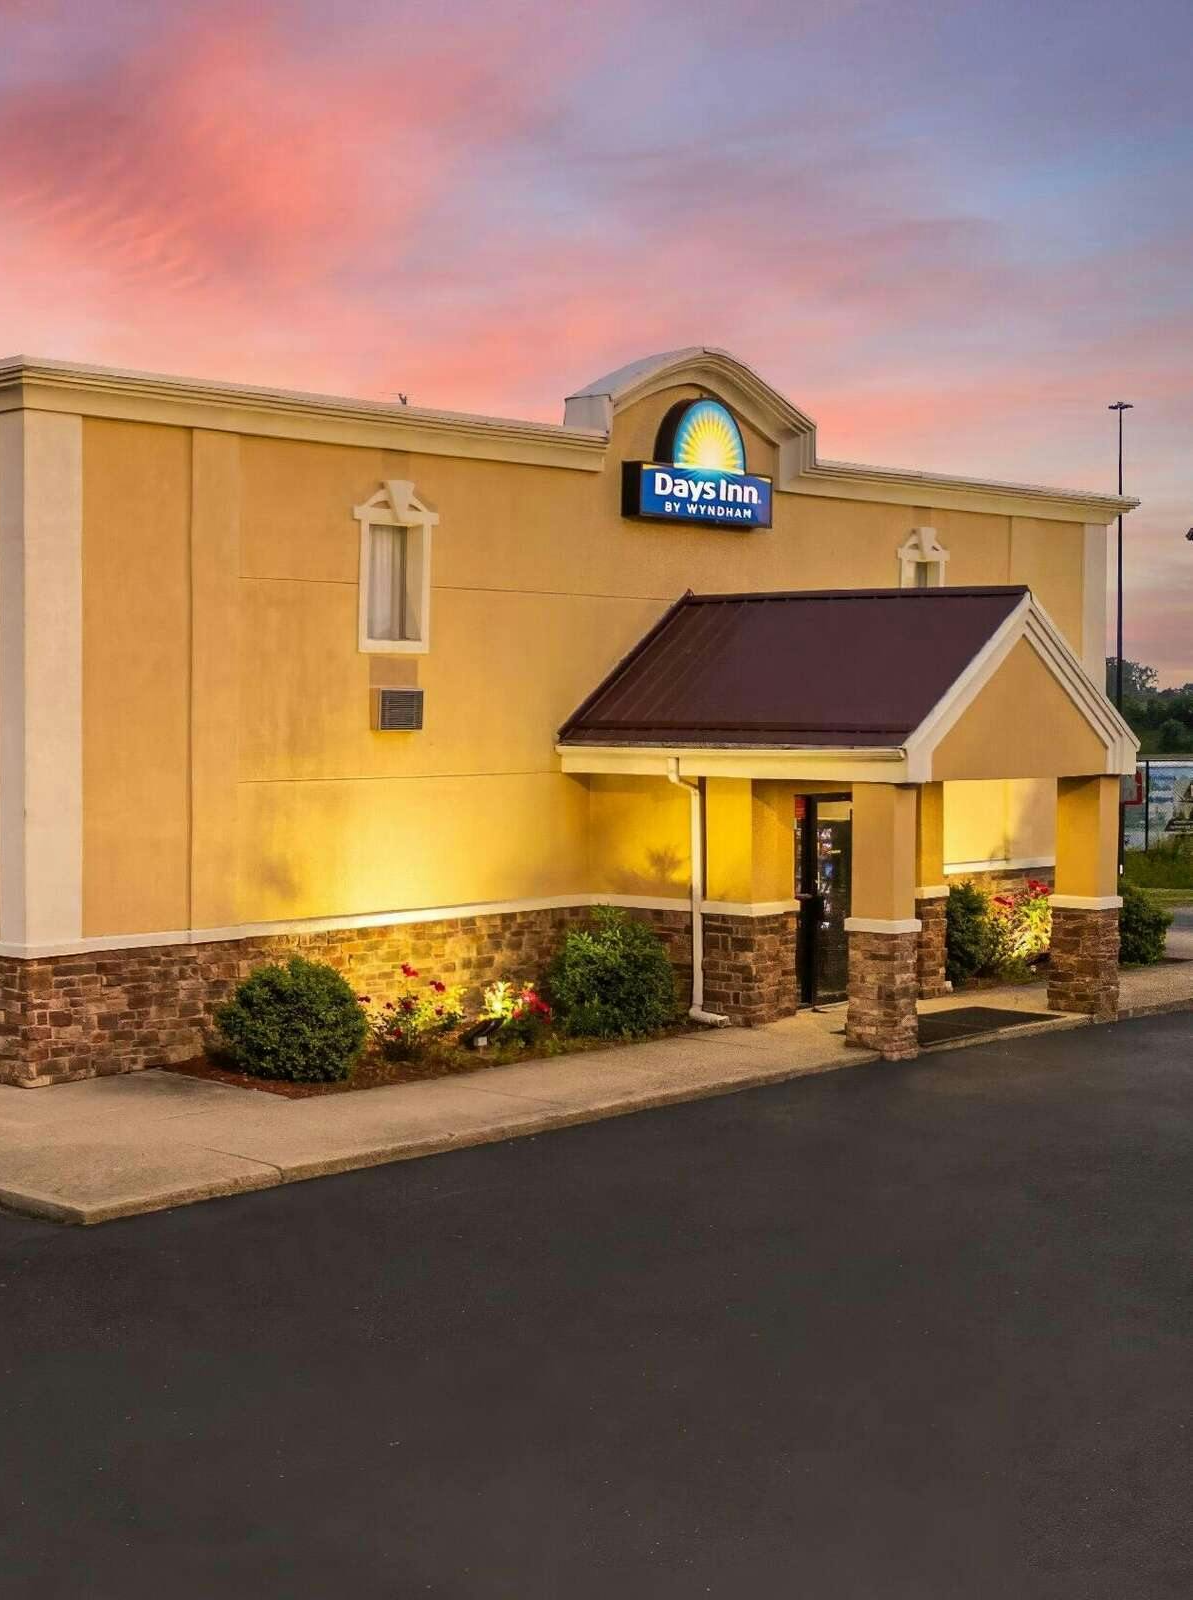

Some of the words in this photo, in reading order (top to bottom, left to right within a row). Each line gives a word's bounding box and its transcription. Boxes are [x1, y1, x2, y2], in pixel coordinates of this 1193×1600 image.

[654, 472, 717, 502] Days
[719, 479, 759, 504] Inn
[665, 501, 681, 512] BY
[686, 503, 752, 519] WYNDHAM
